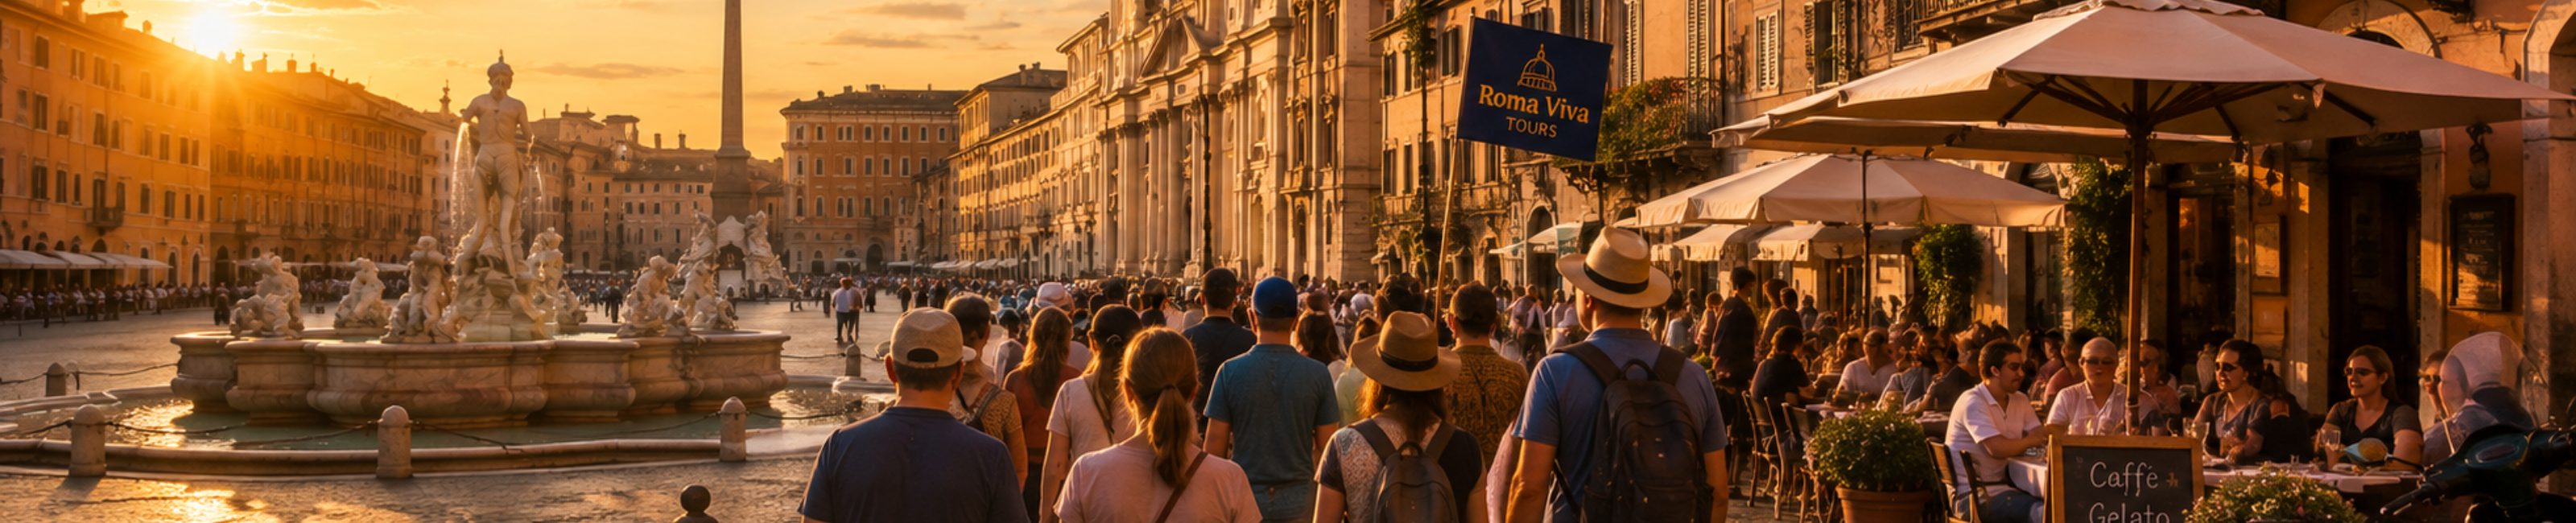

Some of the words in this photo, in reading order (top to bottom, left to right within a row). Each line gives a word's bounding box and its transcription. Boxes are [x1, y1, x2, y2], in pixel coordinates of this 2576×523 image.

[1478, 84, 1539, 115] Roma
[1545, 96, 1590, 124] Viva
[1506, 117, 1558, 138] TOURS
[2089, 502, 2170, 523] Gelato
